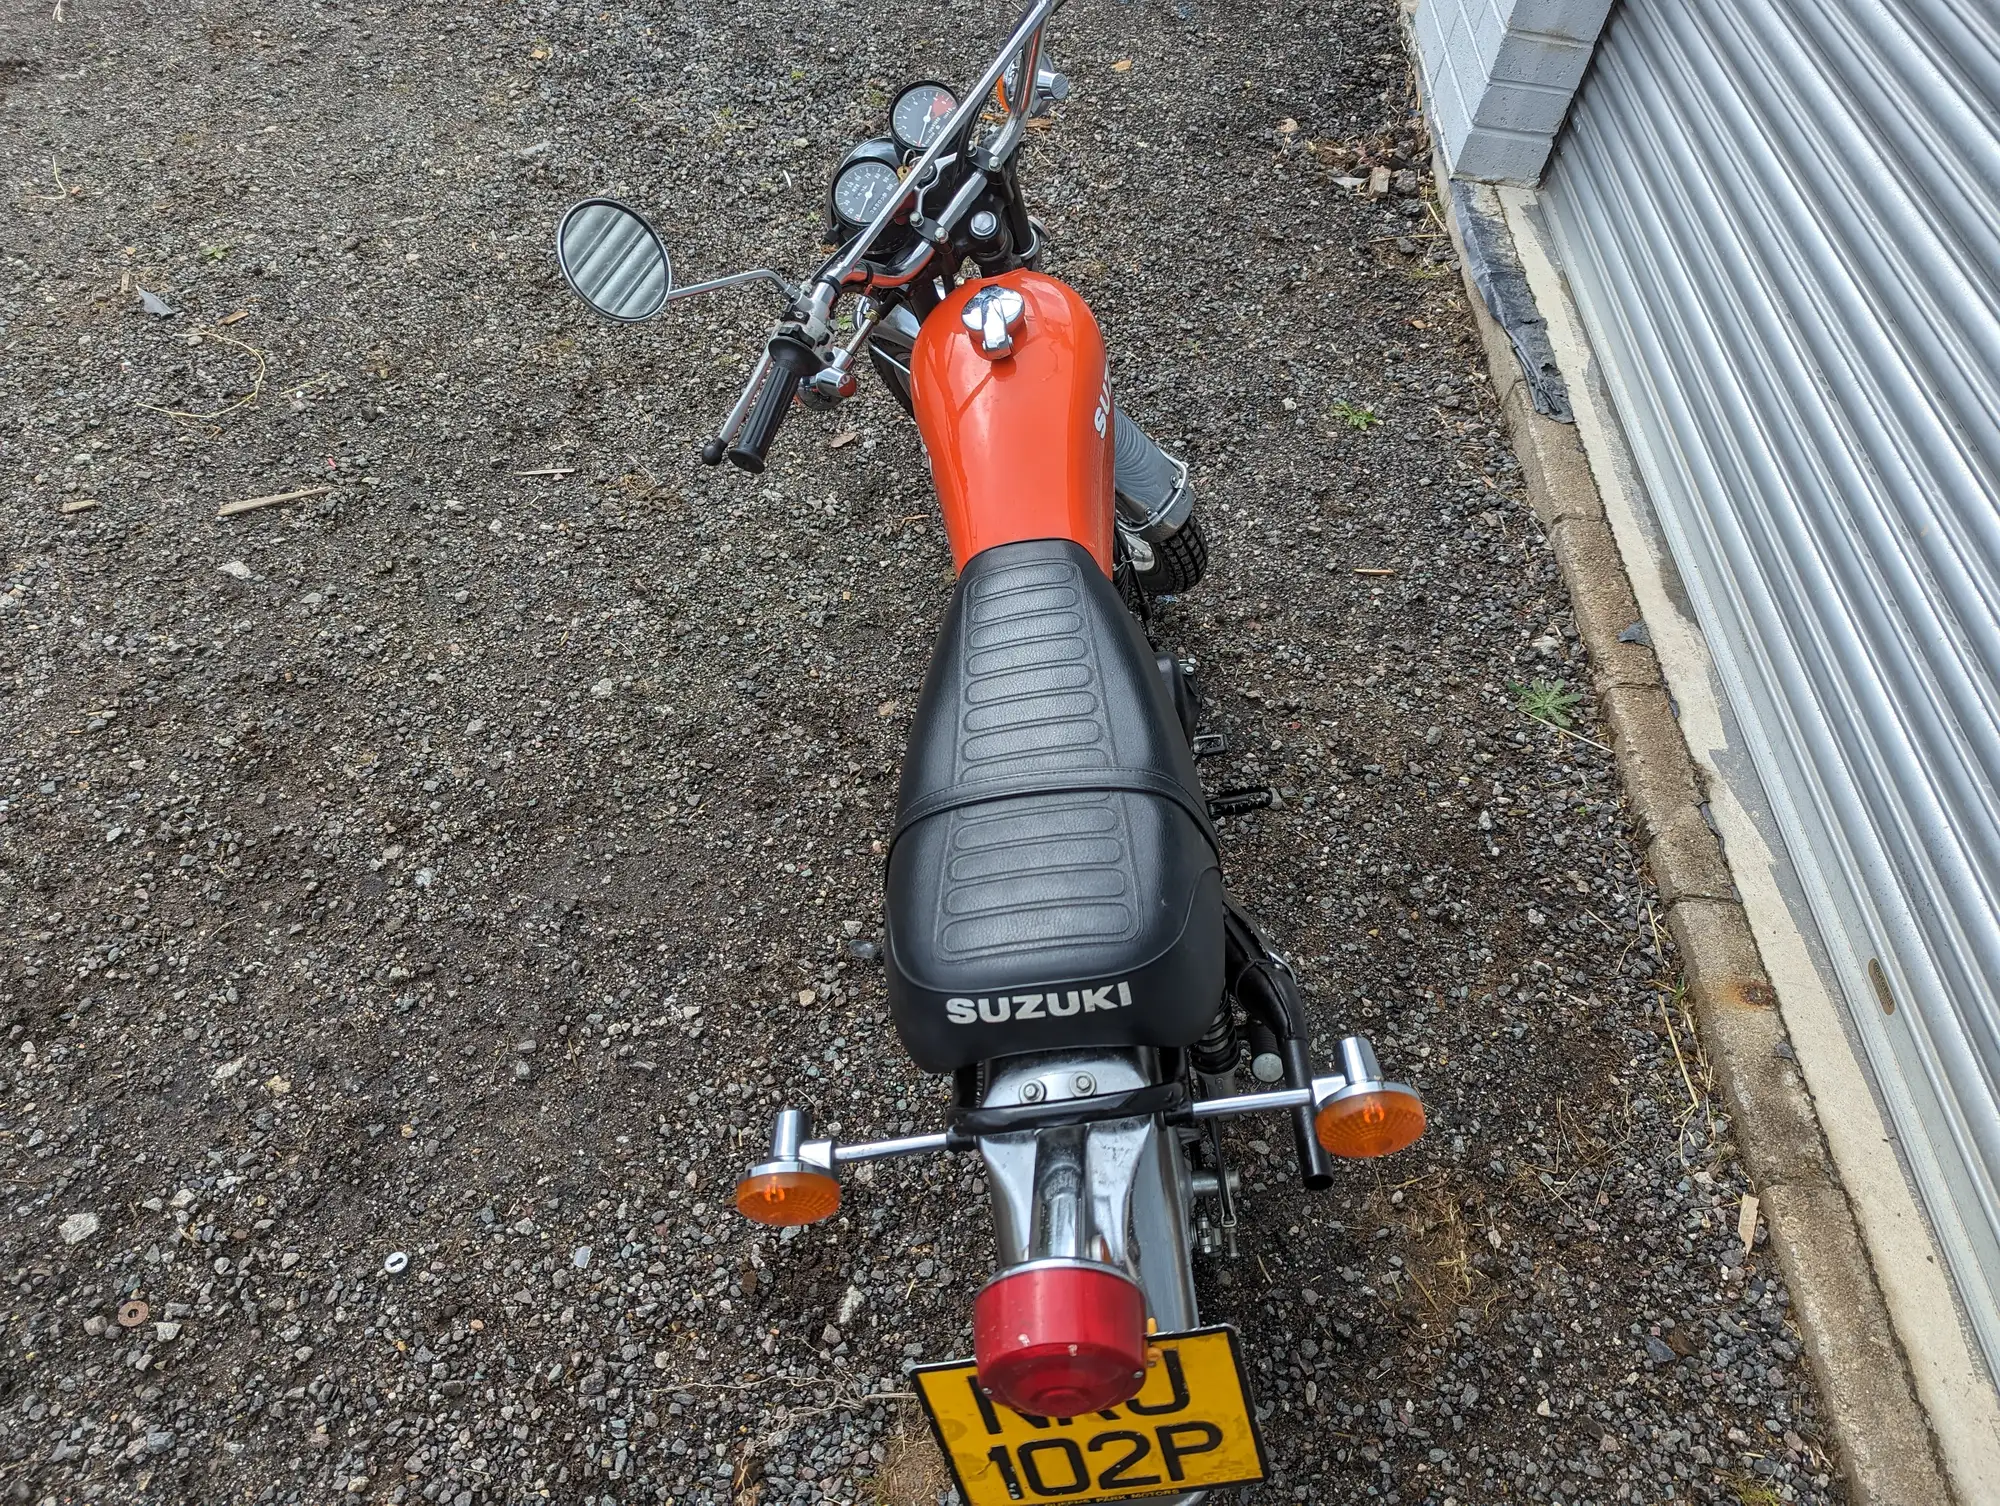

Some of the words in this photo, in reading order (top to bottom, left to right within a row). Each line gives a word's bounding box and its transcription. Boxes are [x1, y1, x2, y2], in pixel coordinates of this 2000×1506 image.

[946, 981, 1132, 1024] SUZUKI
[967, 1350, 1190, 1434] NJ
[988, 1421, 1223, 1500] 102P
[1096, 1494, 1127, 1503] PARK
[1131, 1489, 1181, 1498] MOTORS
